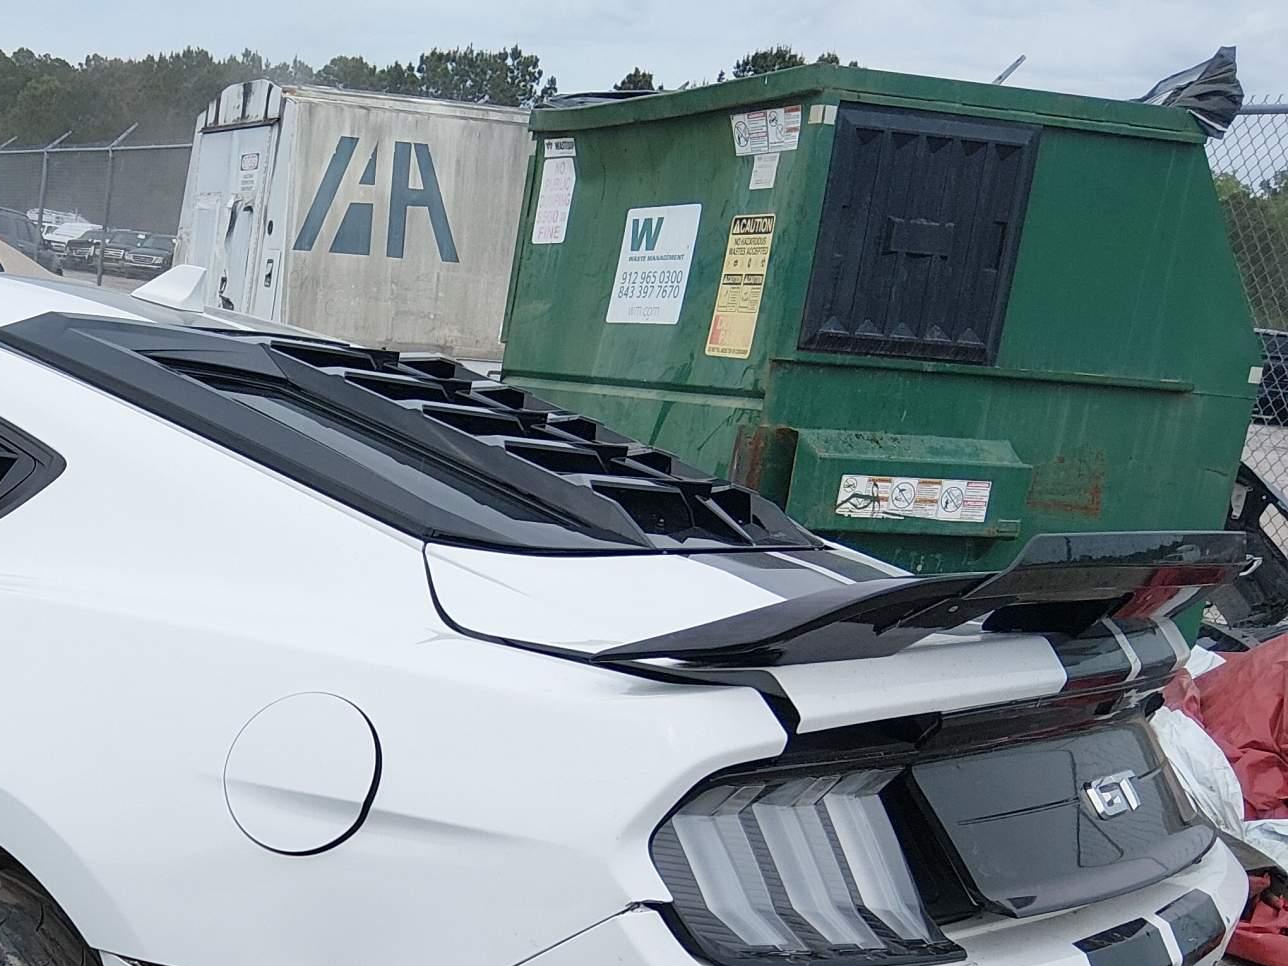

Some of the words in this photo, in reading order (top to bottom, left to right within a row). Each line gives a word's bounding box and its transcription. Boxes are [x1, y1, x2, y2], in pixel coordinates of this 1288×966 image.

[537, 226, 561, 240] FINE
[740, 217, 774, 234] CAUTION
[647, 253, 686, 262] MANAGEMENT
[620, 271, 638, 285] 912
[639, 270, 657, 285] 965
[658, 270, 684, 284] 0300
[617, 286, 636, 299] 843
[636, 285, 655, 299] 397
[656, 284, 681, 299] 7670
[1083, 769, 1141, 821] GT
